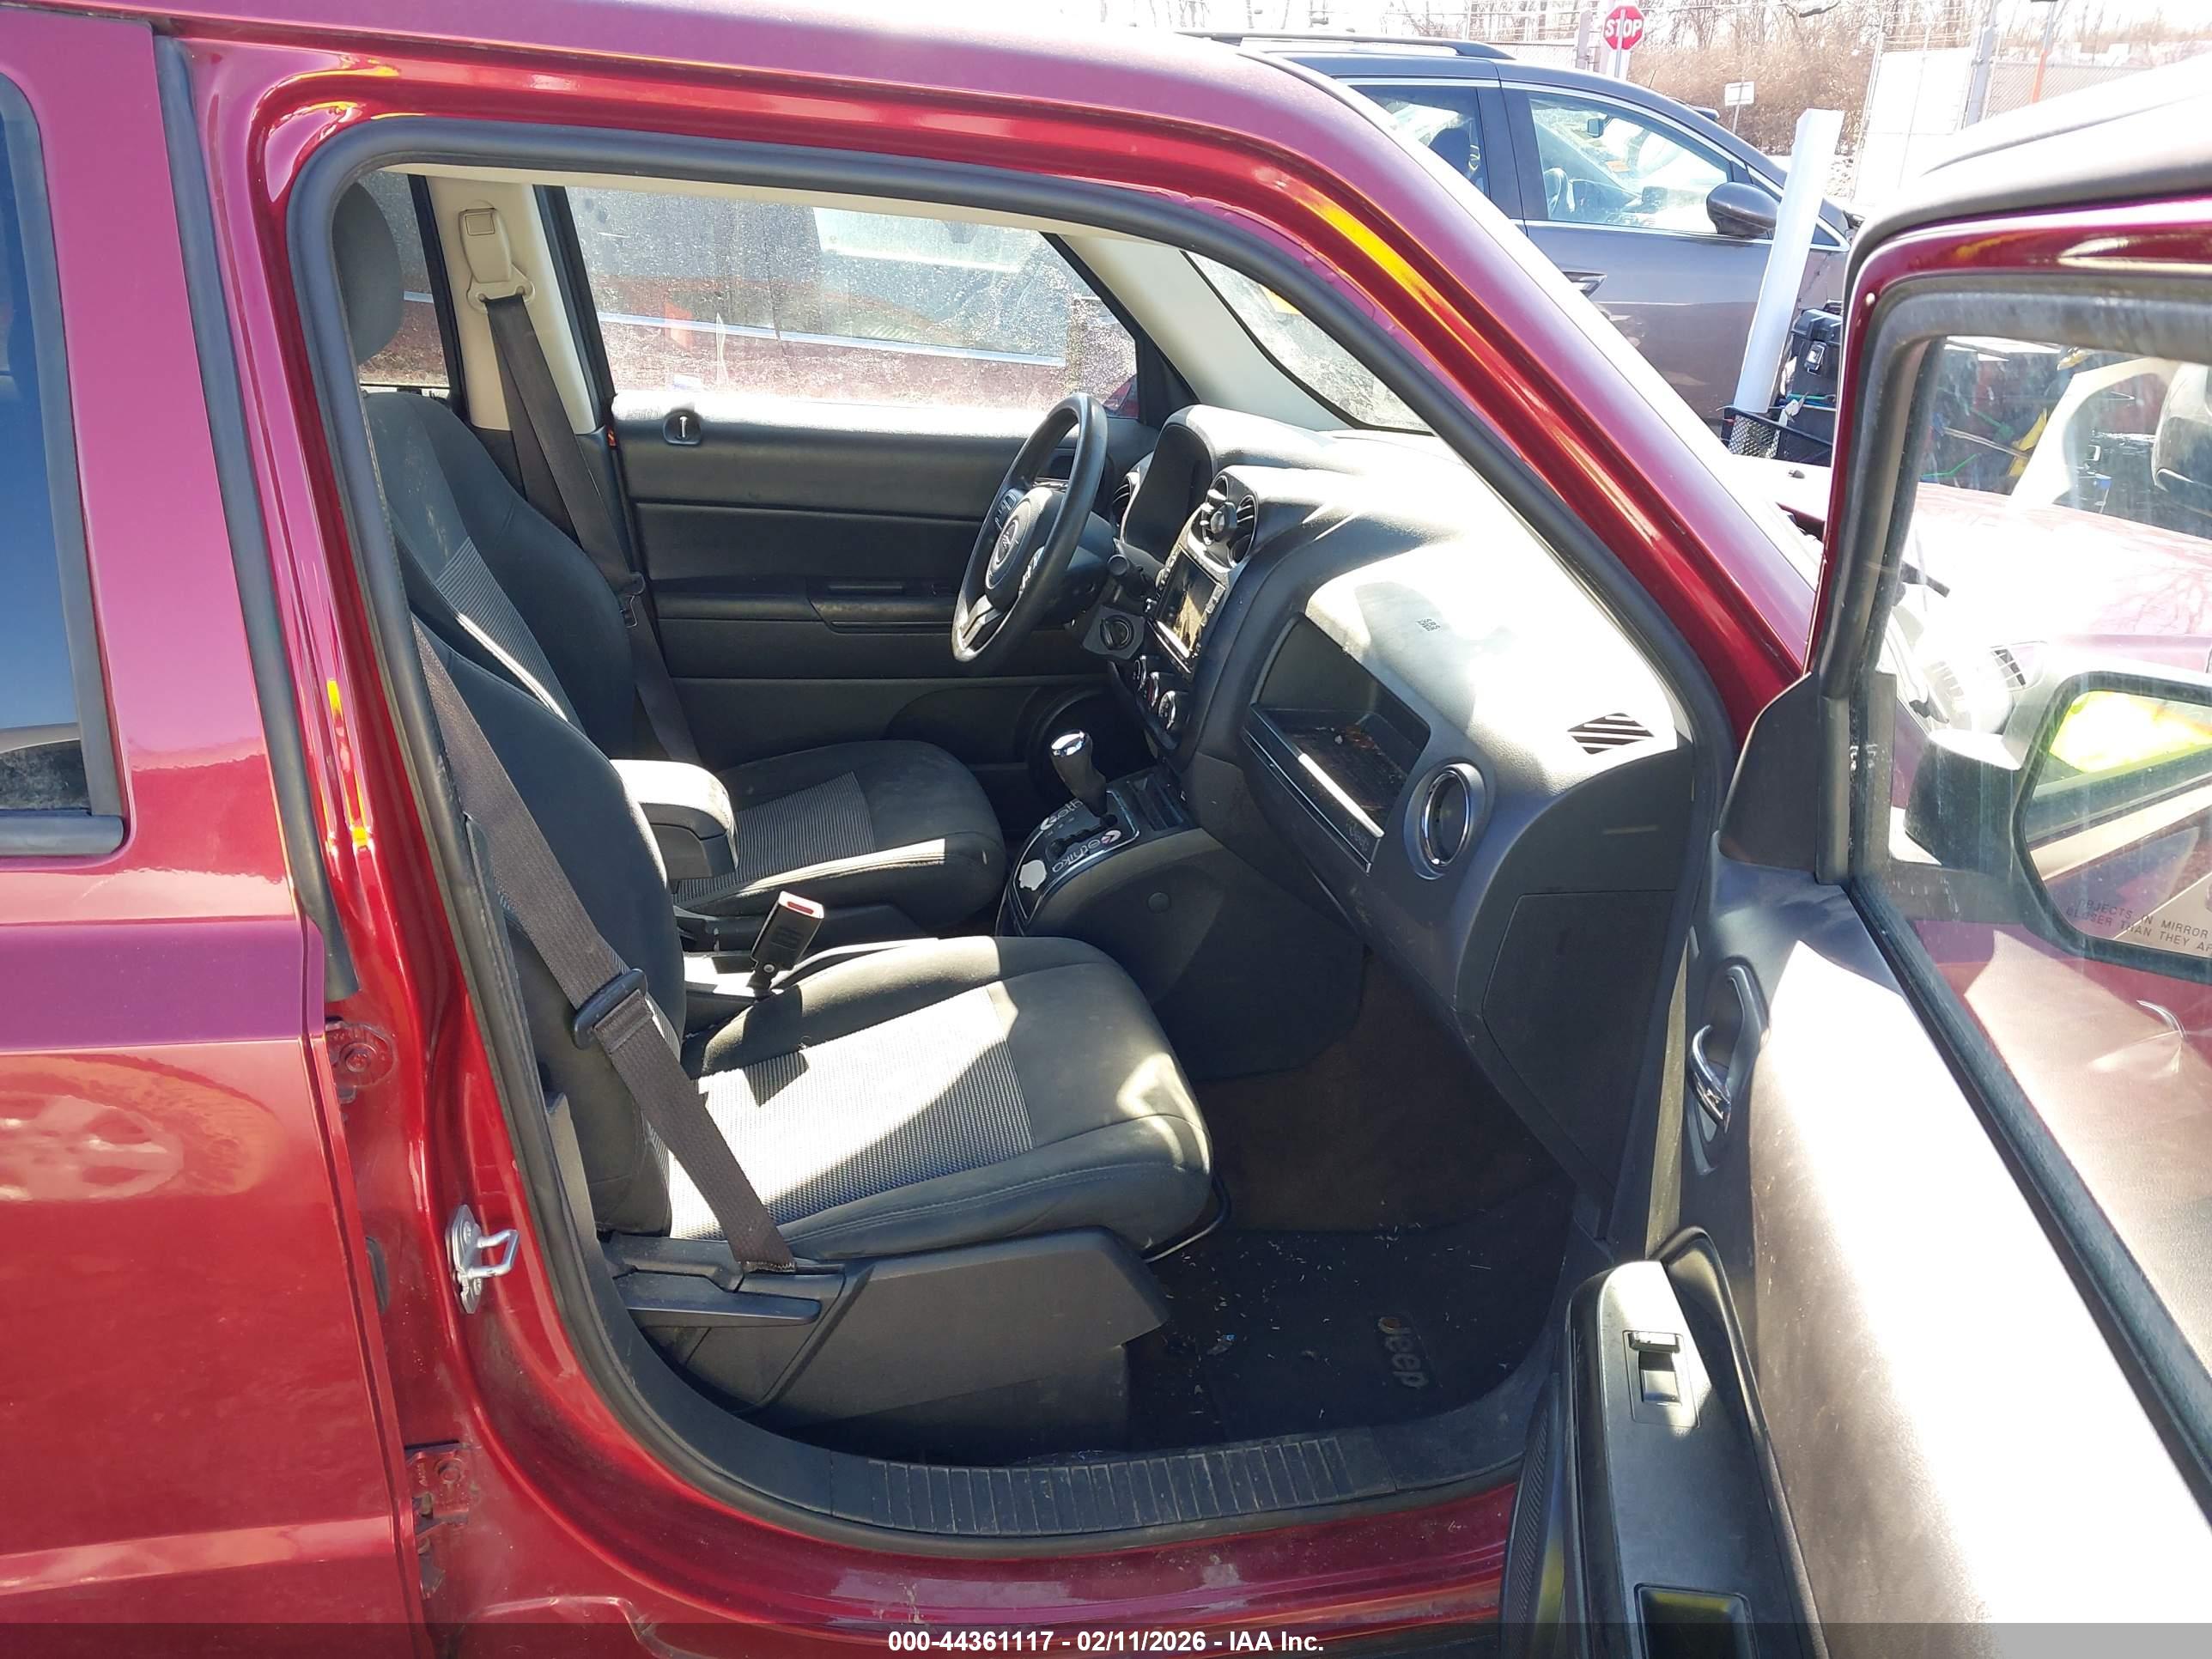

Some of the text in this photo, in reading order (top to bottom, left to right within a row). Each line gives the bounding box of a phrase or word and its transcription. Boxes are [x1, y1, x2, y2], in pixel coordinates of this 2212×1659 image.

[1605, 19, 1643, 39] STOP
[2066, 906, 2112, 927] CLOSER
[2120, 920, 2153, 937] THAN
[2160, 931, 2190, 945] THEY
[2078, 898, 2209, 939] OBJECTS IN MIRROR
[1377, 1316, 1429, 1388] Jeep
